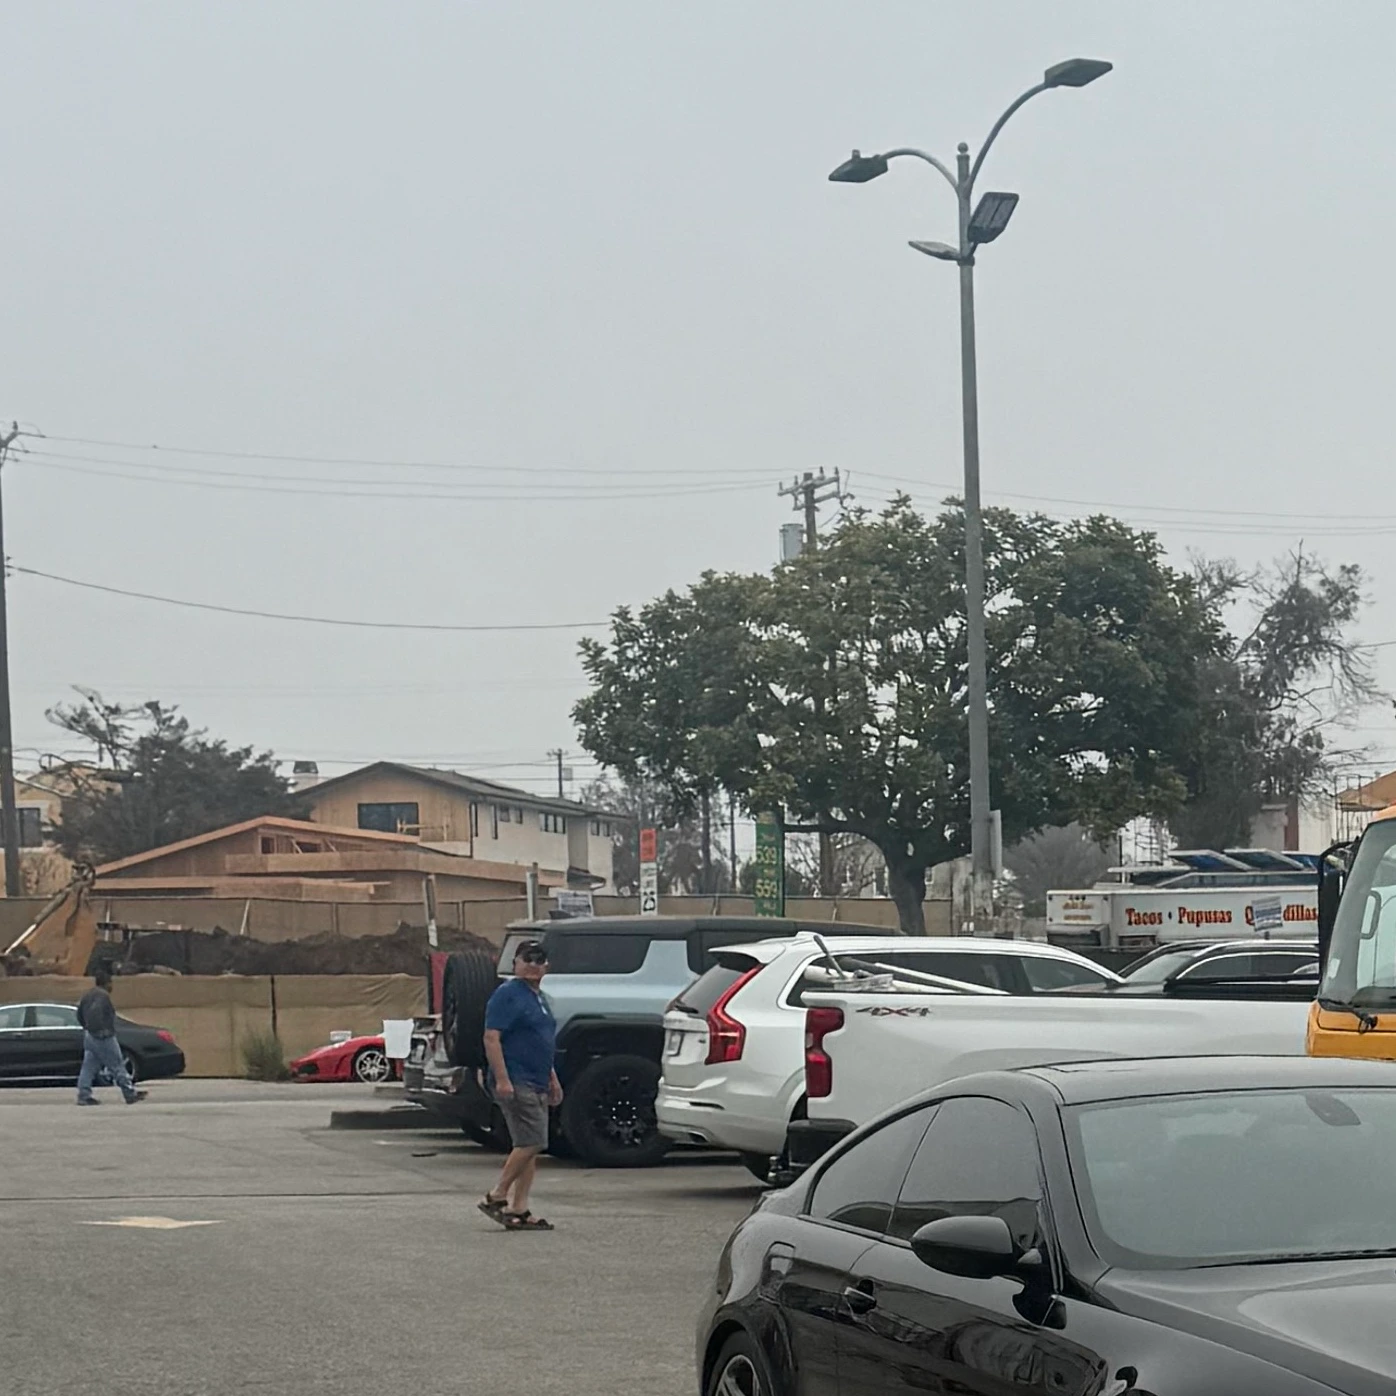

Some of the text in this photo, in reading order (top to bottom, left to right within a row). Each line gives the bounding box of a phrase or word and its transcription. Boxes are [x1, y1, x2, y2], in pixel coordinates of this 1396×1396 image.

[1126, 907, 1163, 926] Tacos
[1178, 906, 1232, 927] Pupusas
[1245, 905, 1318, 926] Qdillas
